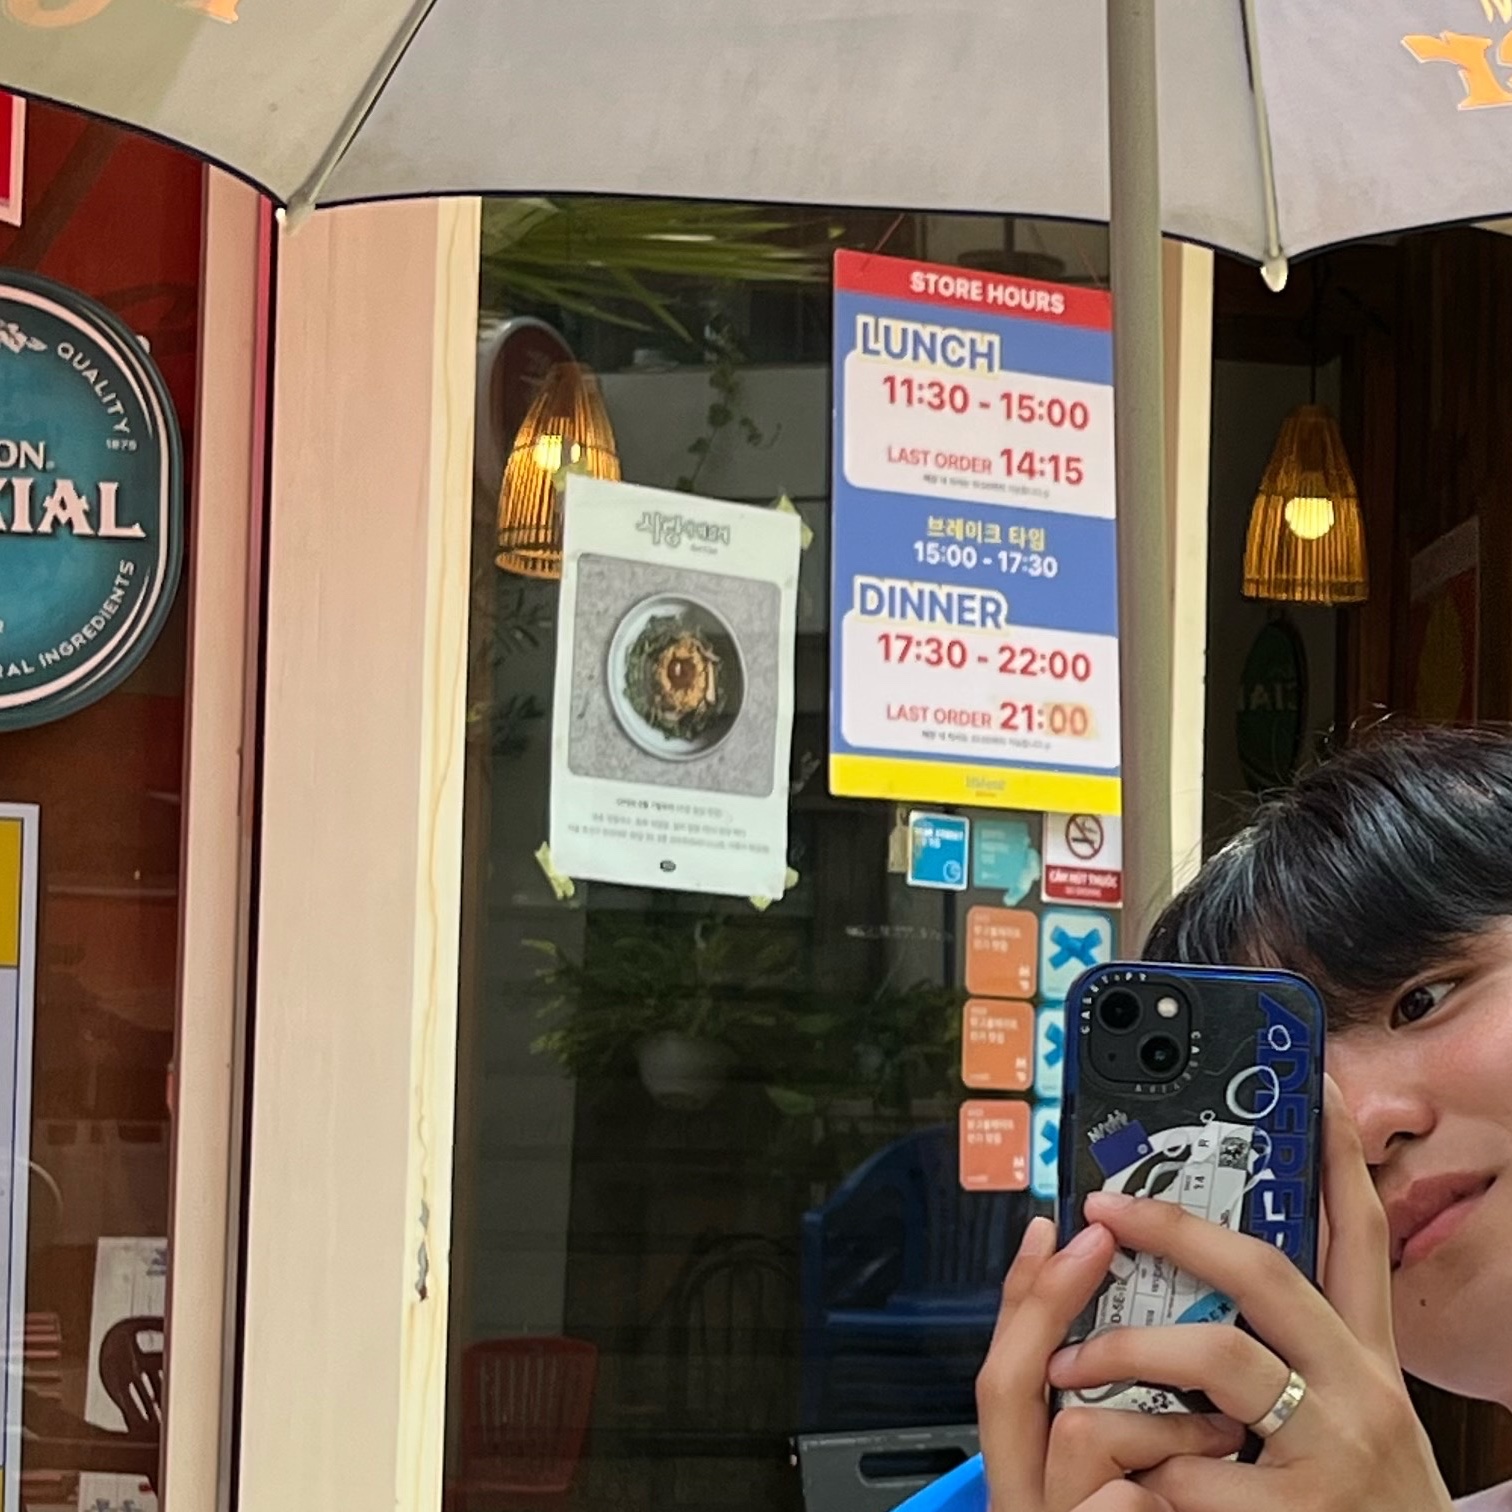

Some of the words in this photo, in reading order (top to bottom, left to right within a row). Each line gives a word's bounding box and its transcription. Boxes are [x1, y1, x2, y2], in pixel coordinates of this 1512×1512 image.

[909, 270, 983, 302] STORE
[987, 282, 1066, 315] HOURS
[861, 320, 997, 374] LUNCH
[57, 342, 131, 434] QUALITY
[883, 374, 971, 415] 11:30
[1000, 391, 1090, 431] 15:00
[887, 445, 931, 468] LAST
[934, 449, 993, 474] ORDER
[1000, 448, 1084, 486] 14:15
[927, 515, 1002, 545] 브레이크
[1008, 525, 1046, 552] 타임
[914, 541, 978, 569] 15:00
[997, 551, 1058, 578] 17:30
[38, 559, 135, 669] INGREDIENTS
[859, 582, 1003, 629] DINNER
[877, 633, 968, 669] 17:30
[998, 646, 1092, 682] 22:00
[886, 703, 931, 723] LAST
[933, 707, 993, 729] ORDER
[1000, 702, 1089, 737] 21:00
